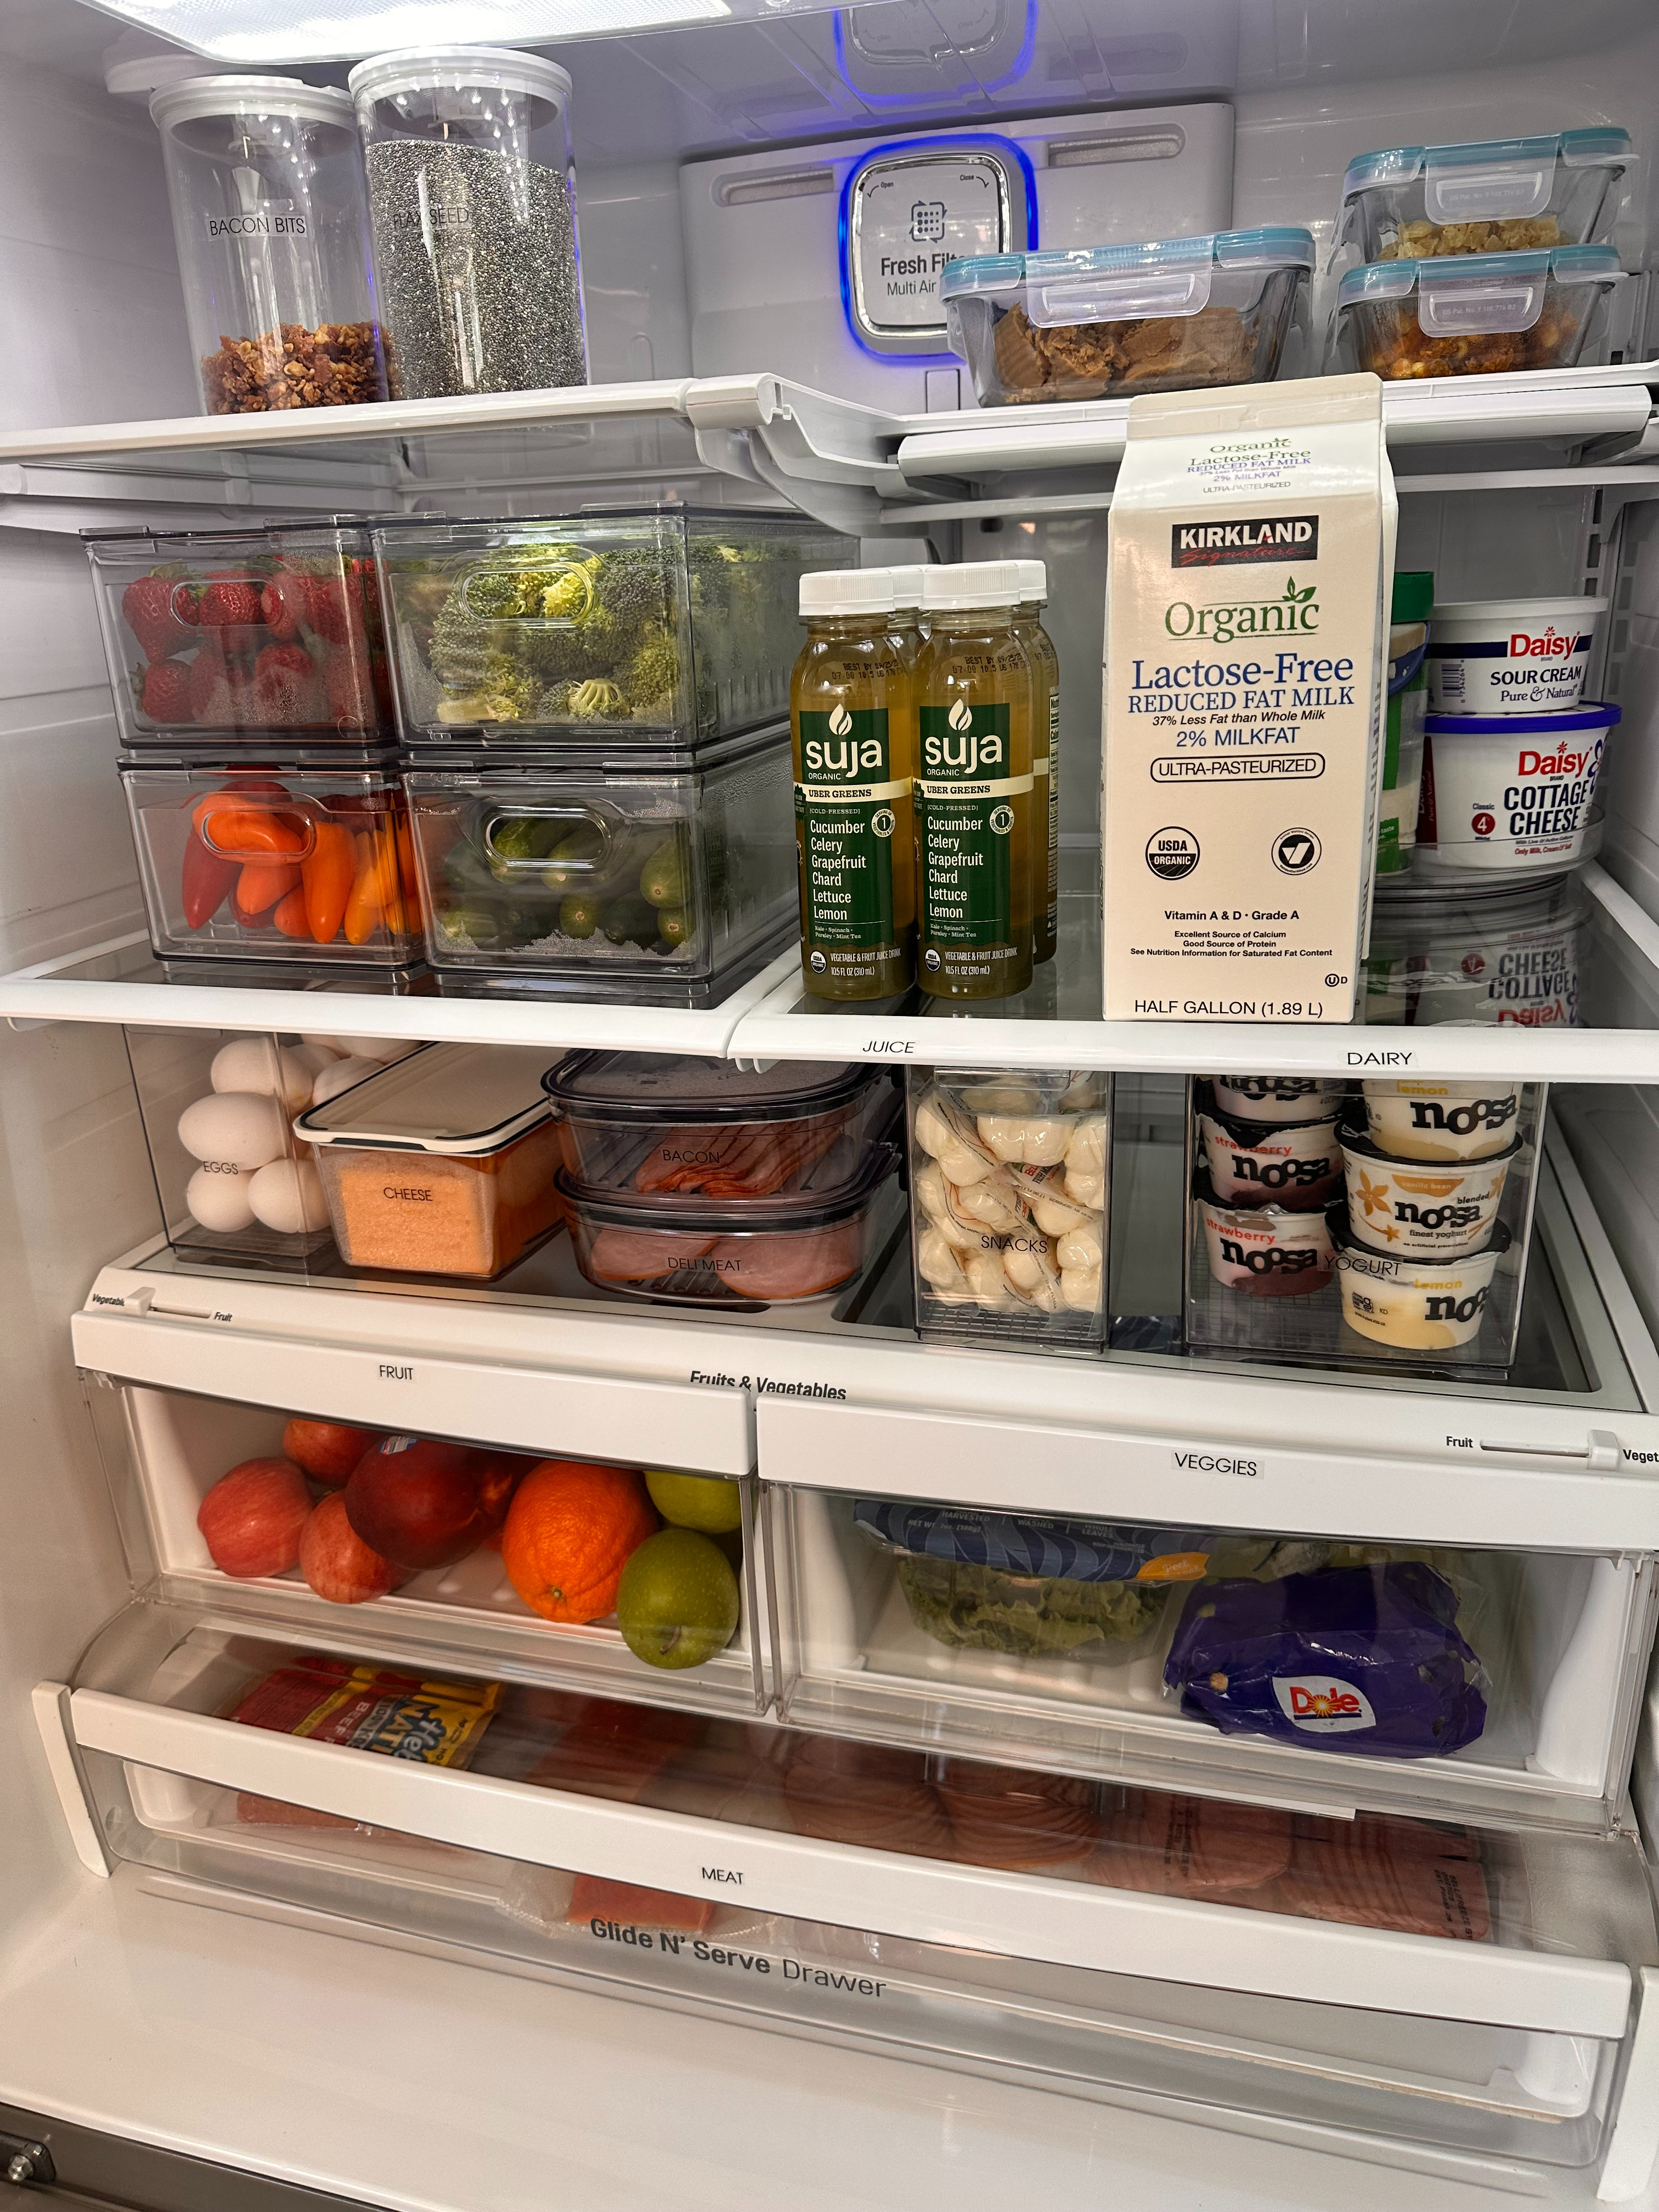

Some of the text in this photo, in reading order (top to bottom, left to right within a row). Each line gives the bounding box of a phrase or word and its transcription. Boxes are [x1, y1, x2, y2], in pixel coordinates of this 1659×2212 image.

[429, 207, 469, 225] SEED
[210, 217, 305, 235] BACON BITS
[881, 255, 927, 276] Fresh
[887, 280, 936, 296] Multi Air
[1210, 441, 1291, 453] Organic
[1190, 450, 1311, 466] Lactose-Free
[1187, 462, 1248, 473] REDUCED
[1235, 471, 1282, 481] MILKFAT
[1203, 481, 1291, 493] ULTRA-PASTEURIZED
[1180, 521, 1313, 549] KIRKLAND
[1178, 546, 1312, 567] Signature
[1165, 601, 1319, 644] Organic
[1509, 630, 1579, 661] Daisy
[1132, 652, 1353, 691] Lactose-Free
[1490, 665, 1582, 686] SOUR CREAM
[1127, 686, 1355, 714] REDUCED FAT MILK
[1500, 686, 1576, 702] Pure & Natural
[1152, 709, 1326, 726] 37% Less Fat than Whole Milk
[1176, 726, 1301, 748] 2% MILKFAT
[806, 740, 882, 778] suja
[925, 735, 1002, 774] suja
[1159, 759, 1317, 777] ULTRA-PASTEURIZED
[1519, 747, 1589, 779] Daisy
[927, 768, 960, 776] ORGANIC
[808, 789, 872, 798] UBER GREENS
[927, 785, 991, 794] UBER GREENS
[1504, 779, 1590, 811] COTTAGE
[810, 820, 865, 834] Cucumber
[882, 817, 886, 829] 1
[928, 816, 983, 831] Cucumber
[1000, 814, 1005, 826] 1
[1510, 806, 1581, 836] CHEESE
[811, 837, 843, 855] Celery
[928, 833, 960, 851] Celery
[1158, 840, 1188, 851] USDA
[811, 855, 867, 872] Grapefruit
[928, 851, 984, 870] Grapefruit
[1154, 855, 1191, 865] ORGANIC
[812, 871, 842, 886] Chard
[929, 869, 958, 884] Chard
[813, 888, 852, 903] Lettuce
[929, 886, 968, 901] Lettuce
[814, 906, 848, 921] Lemon
[929, 903, 963, 918] Lemon
[1164, 910, 1300, 921] Vitamin A & D Grade A
[945, 951, 971, 961] VEGETABLE
[977, 951, 991, 961] FRUIT
[991, 949, 1004, 960] JUICE
[1005, 947, 1018, 958] DRINK
[945, 965, 990, 976] 10.5 FL OZ (310 mL)
[1135, 1000, 1323, 1019] HALF GALLON (1.89 L)
[862, 1040, 915, 1054] JUICE
[1347, 1052, 1413, 1065] DAIRY
[1397, 1081, 1449, 1096] lemon
[1409, 1094, 1516, 1135] noosa
[663, 1149, 720, 1164] BACON
[202, 1161, 239, 1175] EGGS
[1231, 1154, 1330, 1188] noosa
[383, 1187, 433, 1203] CHEESE
[1457, 1191, 1490, 1204] blended
[1394, 1201, 1481, 1229] noosa
[1206, 1218, 1276, 1245] strawberry
[1409, 1229, 1468, 1239] finest yoghurt
[980, 1235, 1048, 1254] SNACKS
[1220, 1237, 1317, 1275] noosa
[668, 1257, 741, 1271] DELI MEAT
[1324, 1254, 1402, 1276] YOGURT
[1414, 1279, 1463, 1290] lemon
[93, 1294, 125, 1306] Vegetabl
[214, 1312, 233, 1322] Fruit
[379, 1365, 414, 1380] FRUIT
[739, 1375, 752, 1392] &
[757, 1376, 847, 1400] Vegetables
[1446, 1436, 1474, 1448] Fruit
[1622, 1449, 1659, 1464] Veget
[1175, 1452, 1257, 1477] VEGGIES
[941, 1512, 990, 1522] HARVESTED
[1018, 1518, 1054, 1529] WASHED
[1162, 1559, 1188, 1572] Peel
[1290, 1686, 1359, 1715] Dole
[702, 1867, 743, 1885] MEAT
[591, 1918, 887, 1998] Glide N' Serve Drawer
